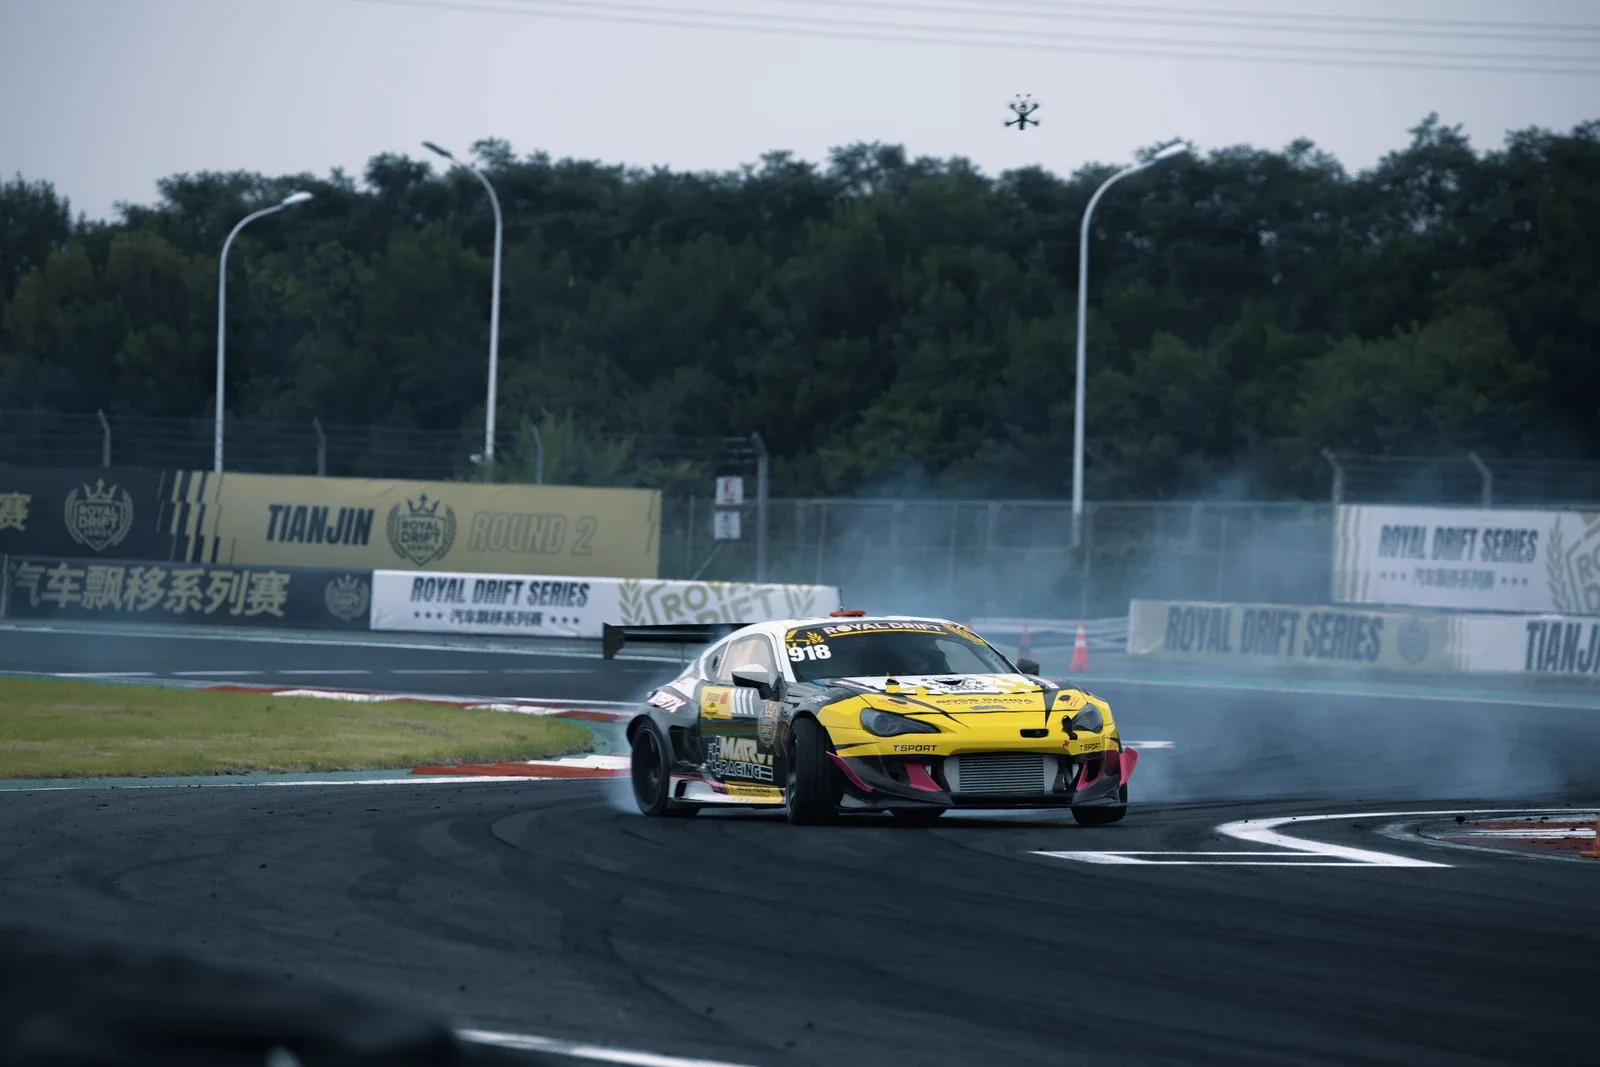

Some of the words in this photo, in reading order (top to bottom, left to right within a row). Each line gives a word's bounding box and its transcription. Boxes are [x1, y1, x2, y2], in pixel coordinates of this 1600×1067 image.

[266, 503, 375, 546] TIANJIN
[466, 510, 568, 555] ROUND
[570, 514, 599, 556] 2
[1480, 527, 1540, 564] SERIES
[10, 560, 291, 619] 汽车飘移系列赛
[410, 576, 465, 603] ROYAL
[472, 578, 525, 606] DRIFT
[526, 580, 590, 608] SERIES
[822, 622, 889, 635] ROYAL
[890, 622, 942, 632] DRIFT
[1164, 605, 1233, 653] ROYAL
[1240, 608, 1300, 657] DRIFT
[1303, 611, 1385, 662] SERIES
[788, 644, 832, 662] 918
